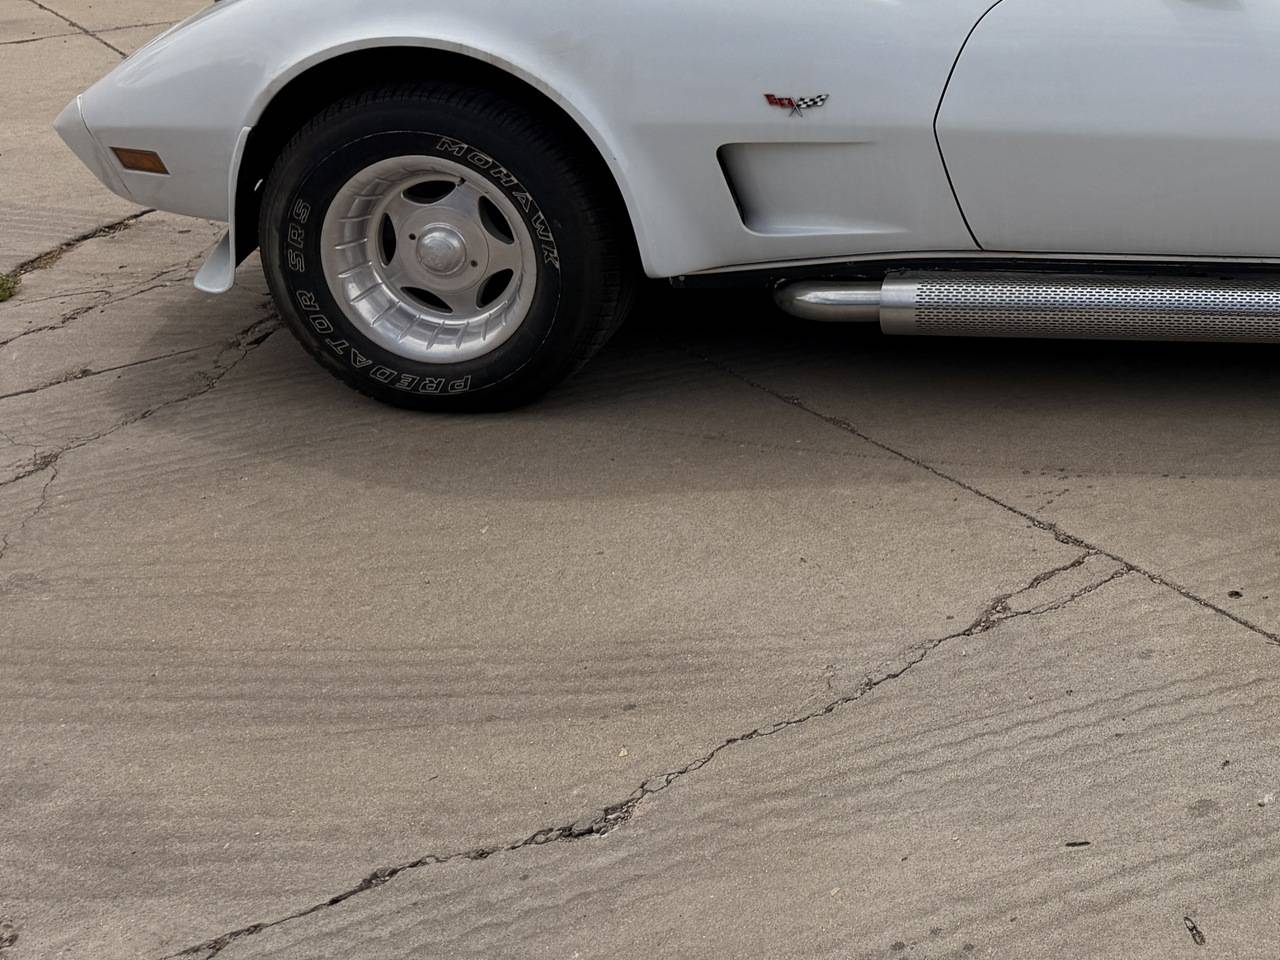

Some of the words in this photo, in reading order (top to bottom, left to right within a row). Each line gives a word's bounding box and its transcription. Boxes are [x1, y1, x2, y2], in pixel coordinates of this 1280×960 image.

[287, 197, 313, 273] SRS
[436, 137, 560, 270] MOHAWK
[295, 289, 473, 394] PREDATOR
